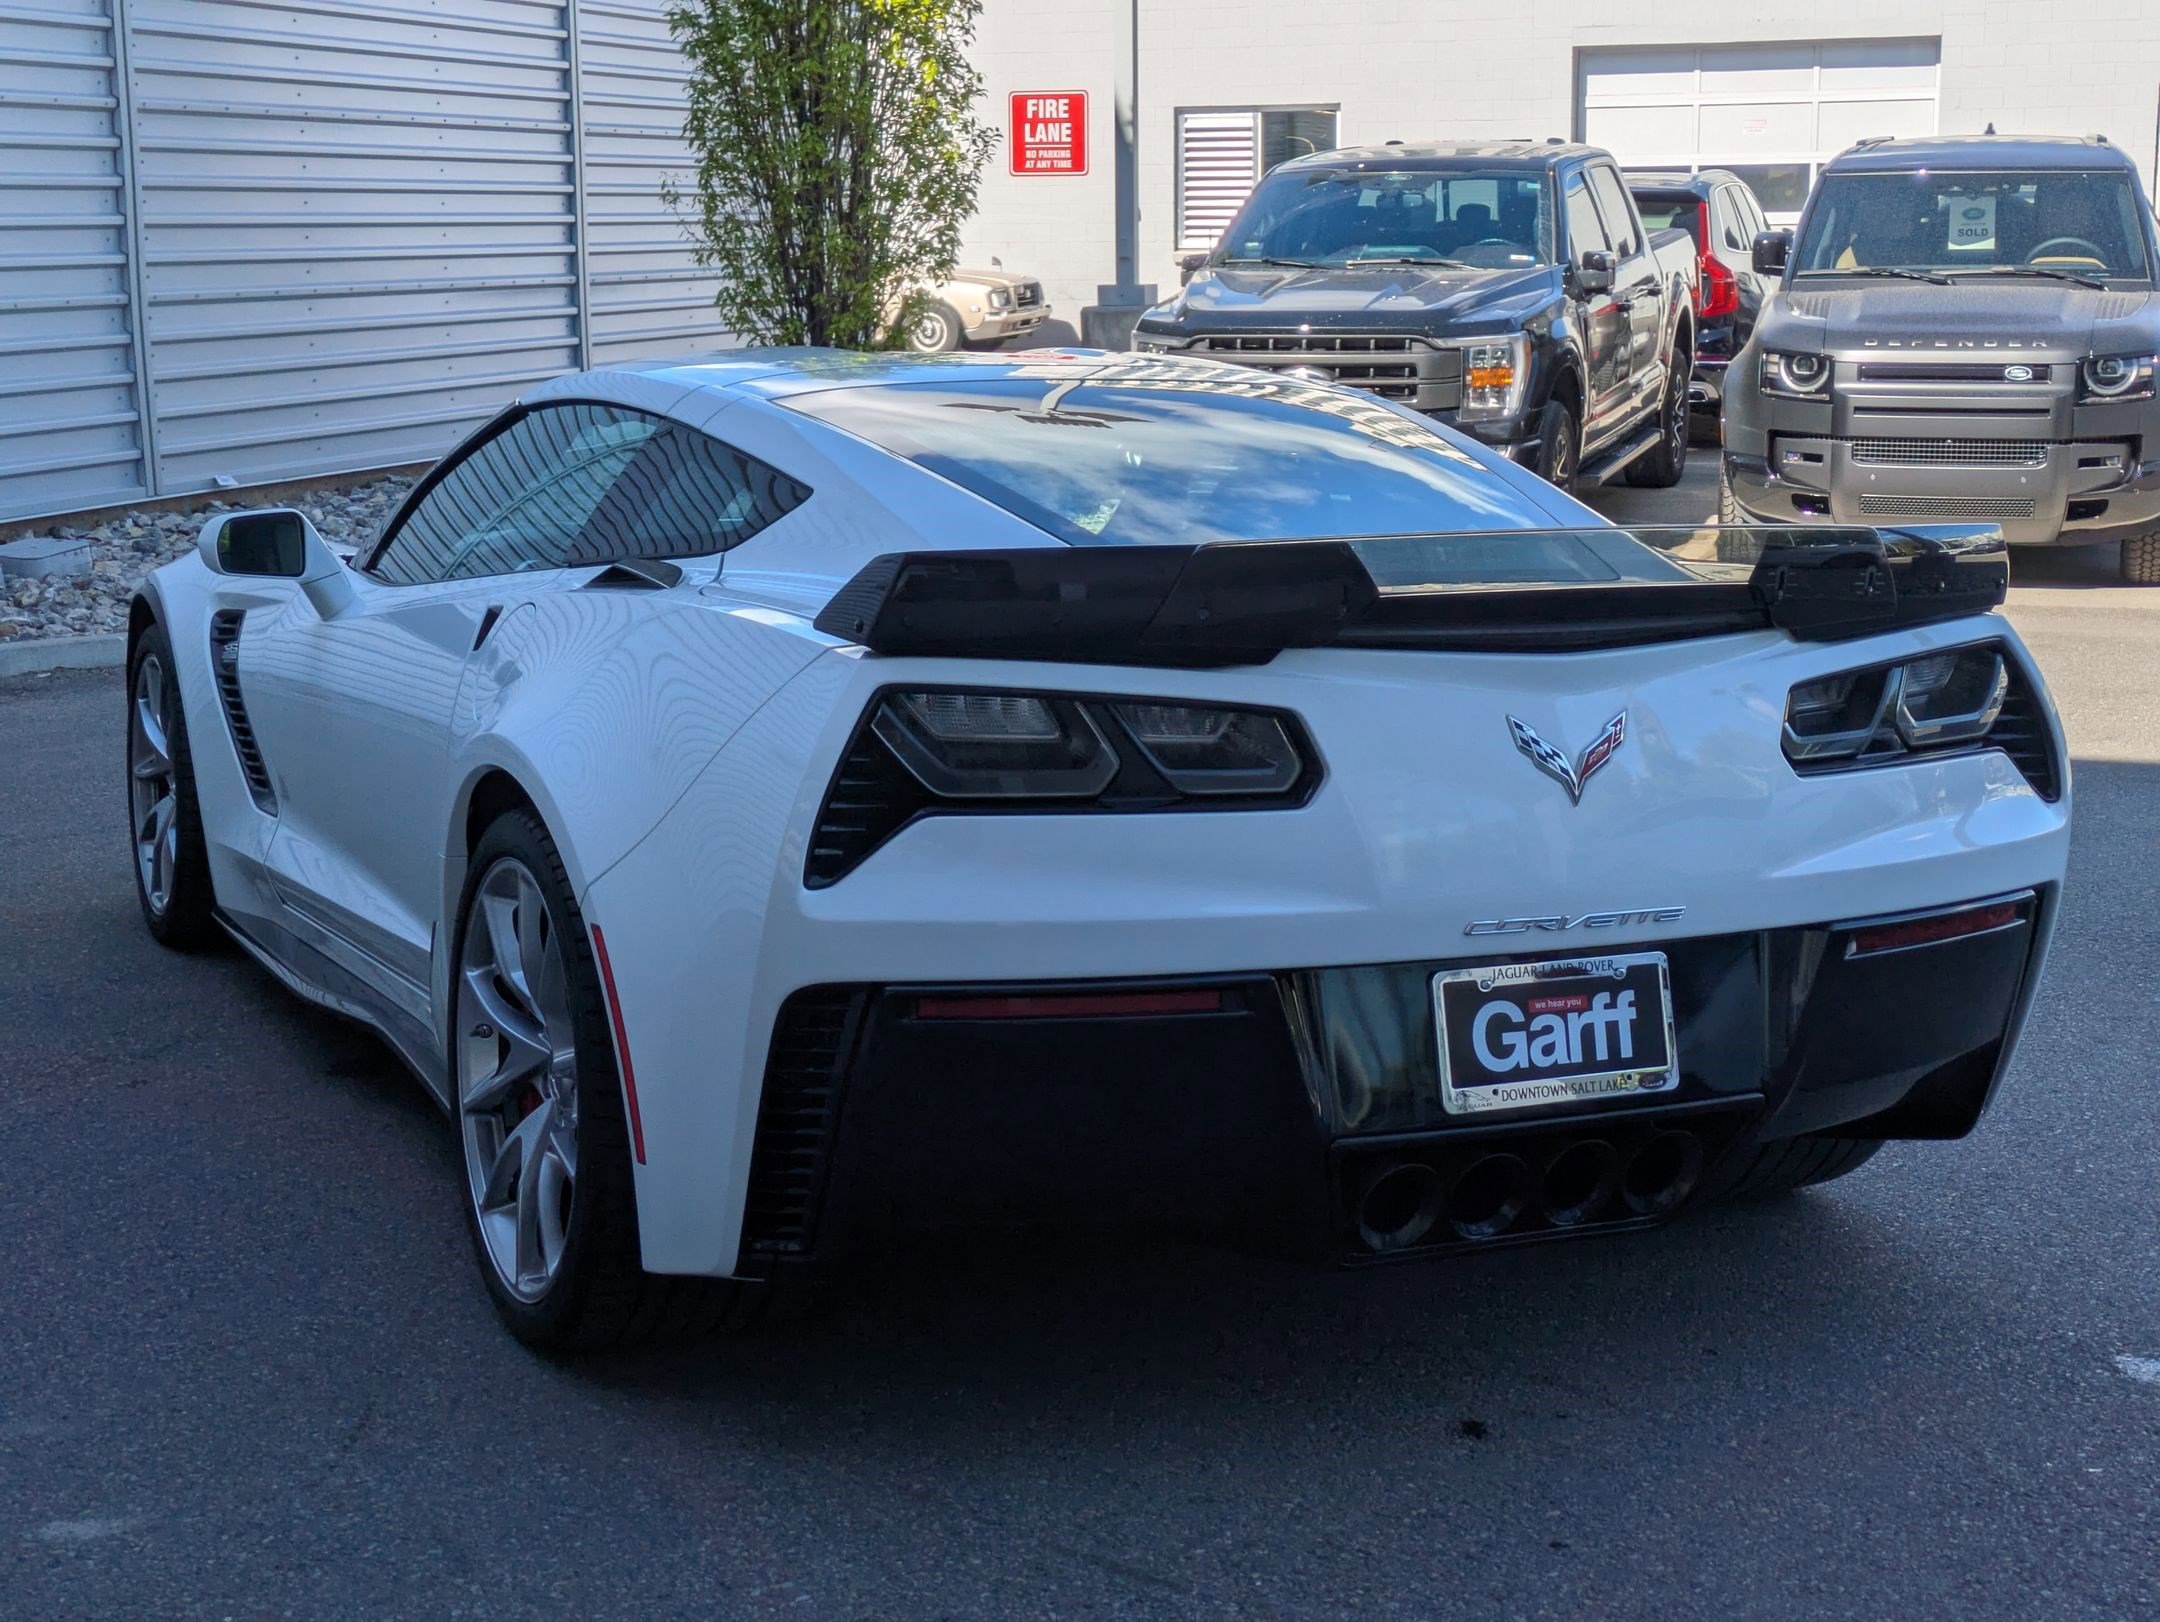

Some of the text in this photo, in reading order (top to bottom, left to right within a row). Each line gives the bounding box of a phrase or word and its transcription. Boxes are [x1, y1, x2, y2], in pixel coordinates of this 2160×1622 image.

[1026, 98, 1069, 118] FIRE
[1024, 122, 1072, 142] LANE
[1024, 160, 1072, 168] AT ANY TIME
[1025, 149, 1071, 159] NO PARKING
[1957, 228, 1989, 237] SOLD
[1864, 337, 2047, 347] DEFENDER
[1463, 905, 1687, 936] CORVETTE
[1491, 965, 1537, 981] JAGUAR
[1577, 959, 1614, 974] ROVER
[1534, 998, 1582, 1010] we hear you
[1472, 989, 1637, 1072] Garff
[1501, 1083, 1568, 1102] DOWNTOWN
[1571, 1080, 1597, 1095] SALT
[1599, 1076, 1627, 1092] LAKE
